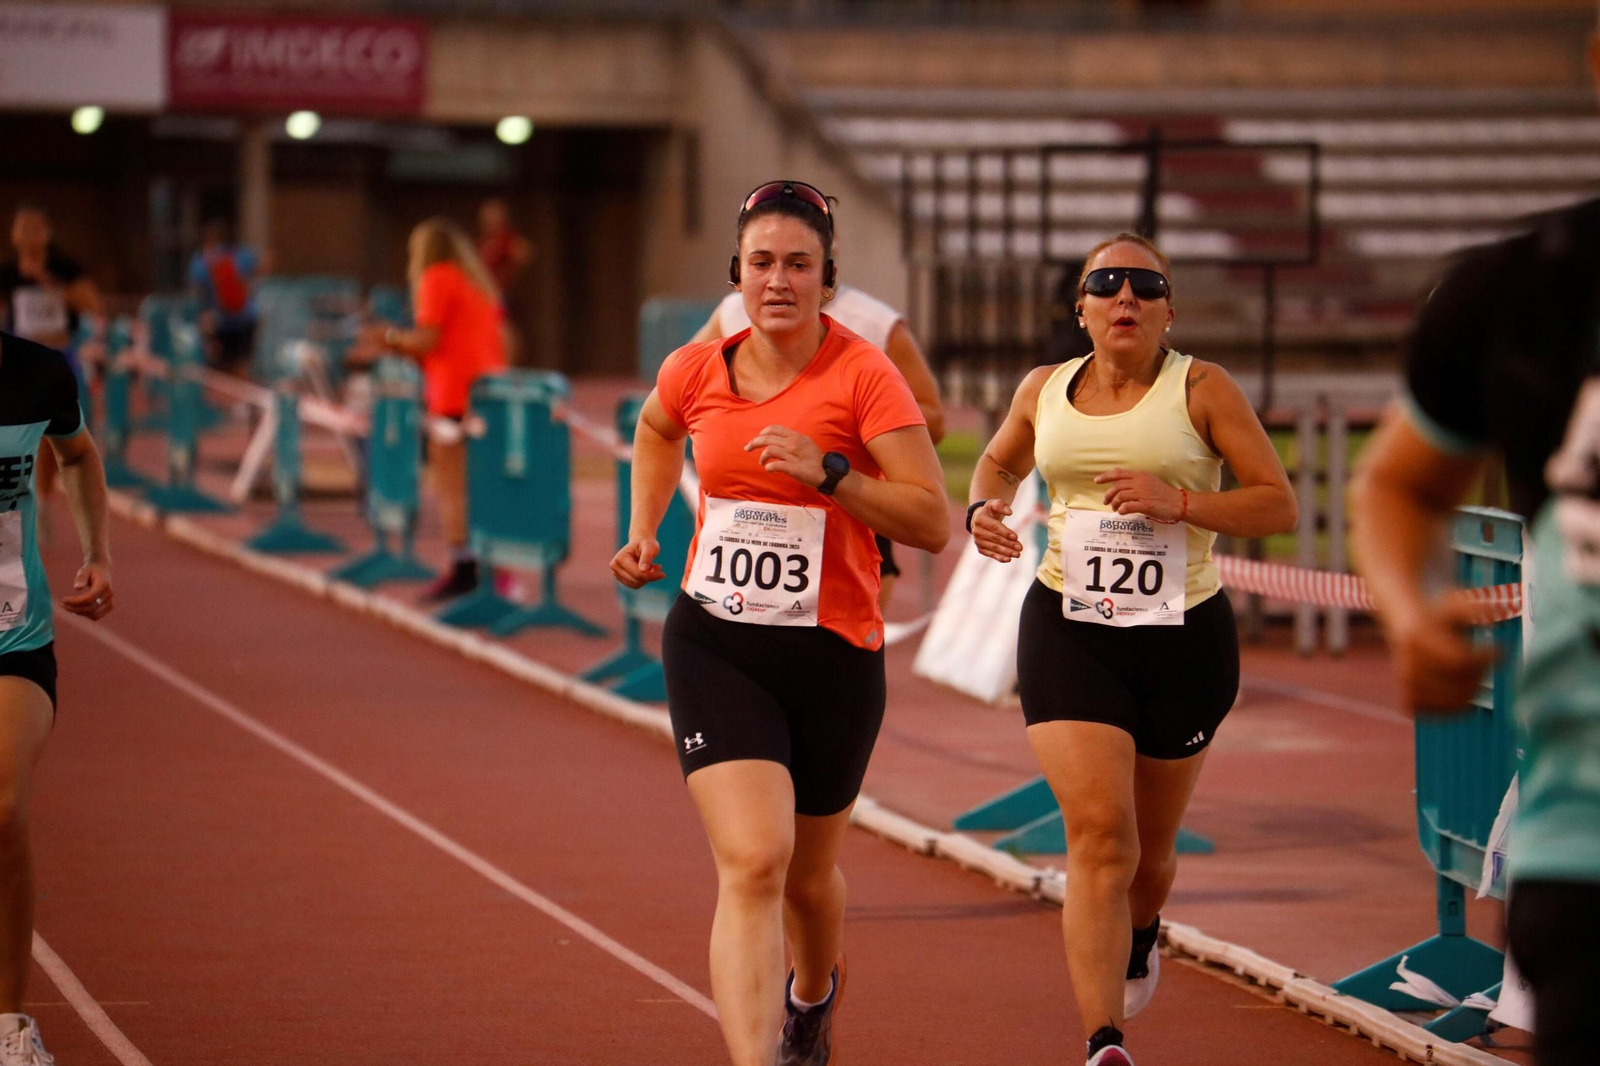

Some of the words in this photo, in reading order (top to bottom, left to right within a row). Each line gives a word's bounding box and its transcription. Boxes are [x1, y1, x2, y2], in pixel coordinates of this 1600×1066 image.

[232, 27, 420, 75] IMDECO
[734, 512, 787, 523] populares
[735, 508, 778, 518] carreras
[1099, 523, 1154, 533] populares
[1100, 519, 1145, 527] carreras
[705, 545, 809, 593] 1003
[1085, 556, 1163, 596] 120
[746, 601, 779, 609] fundaciones
